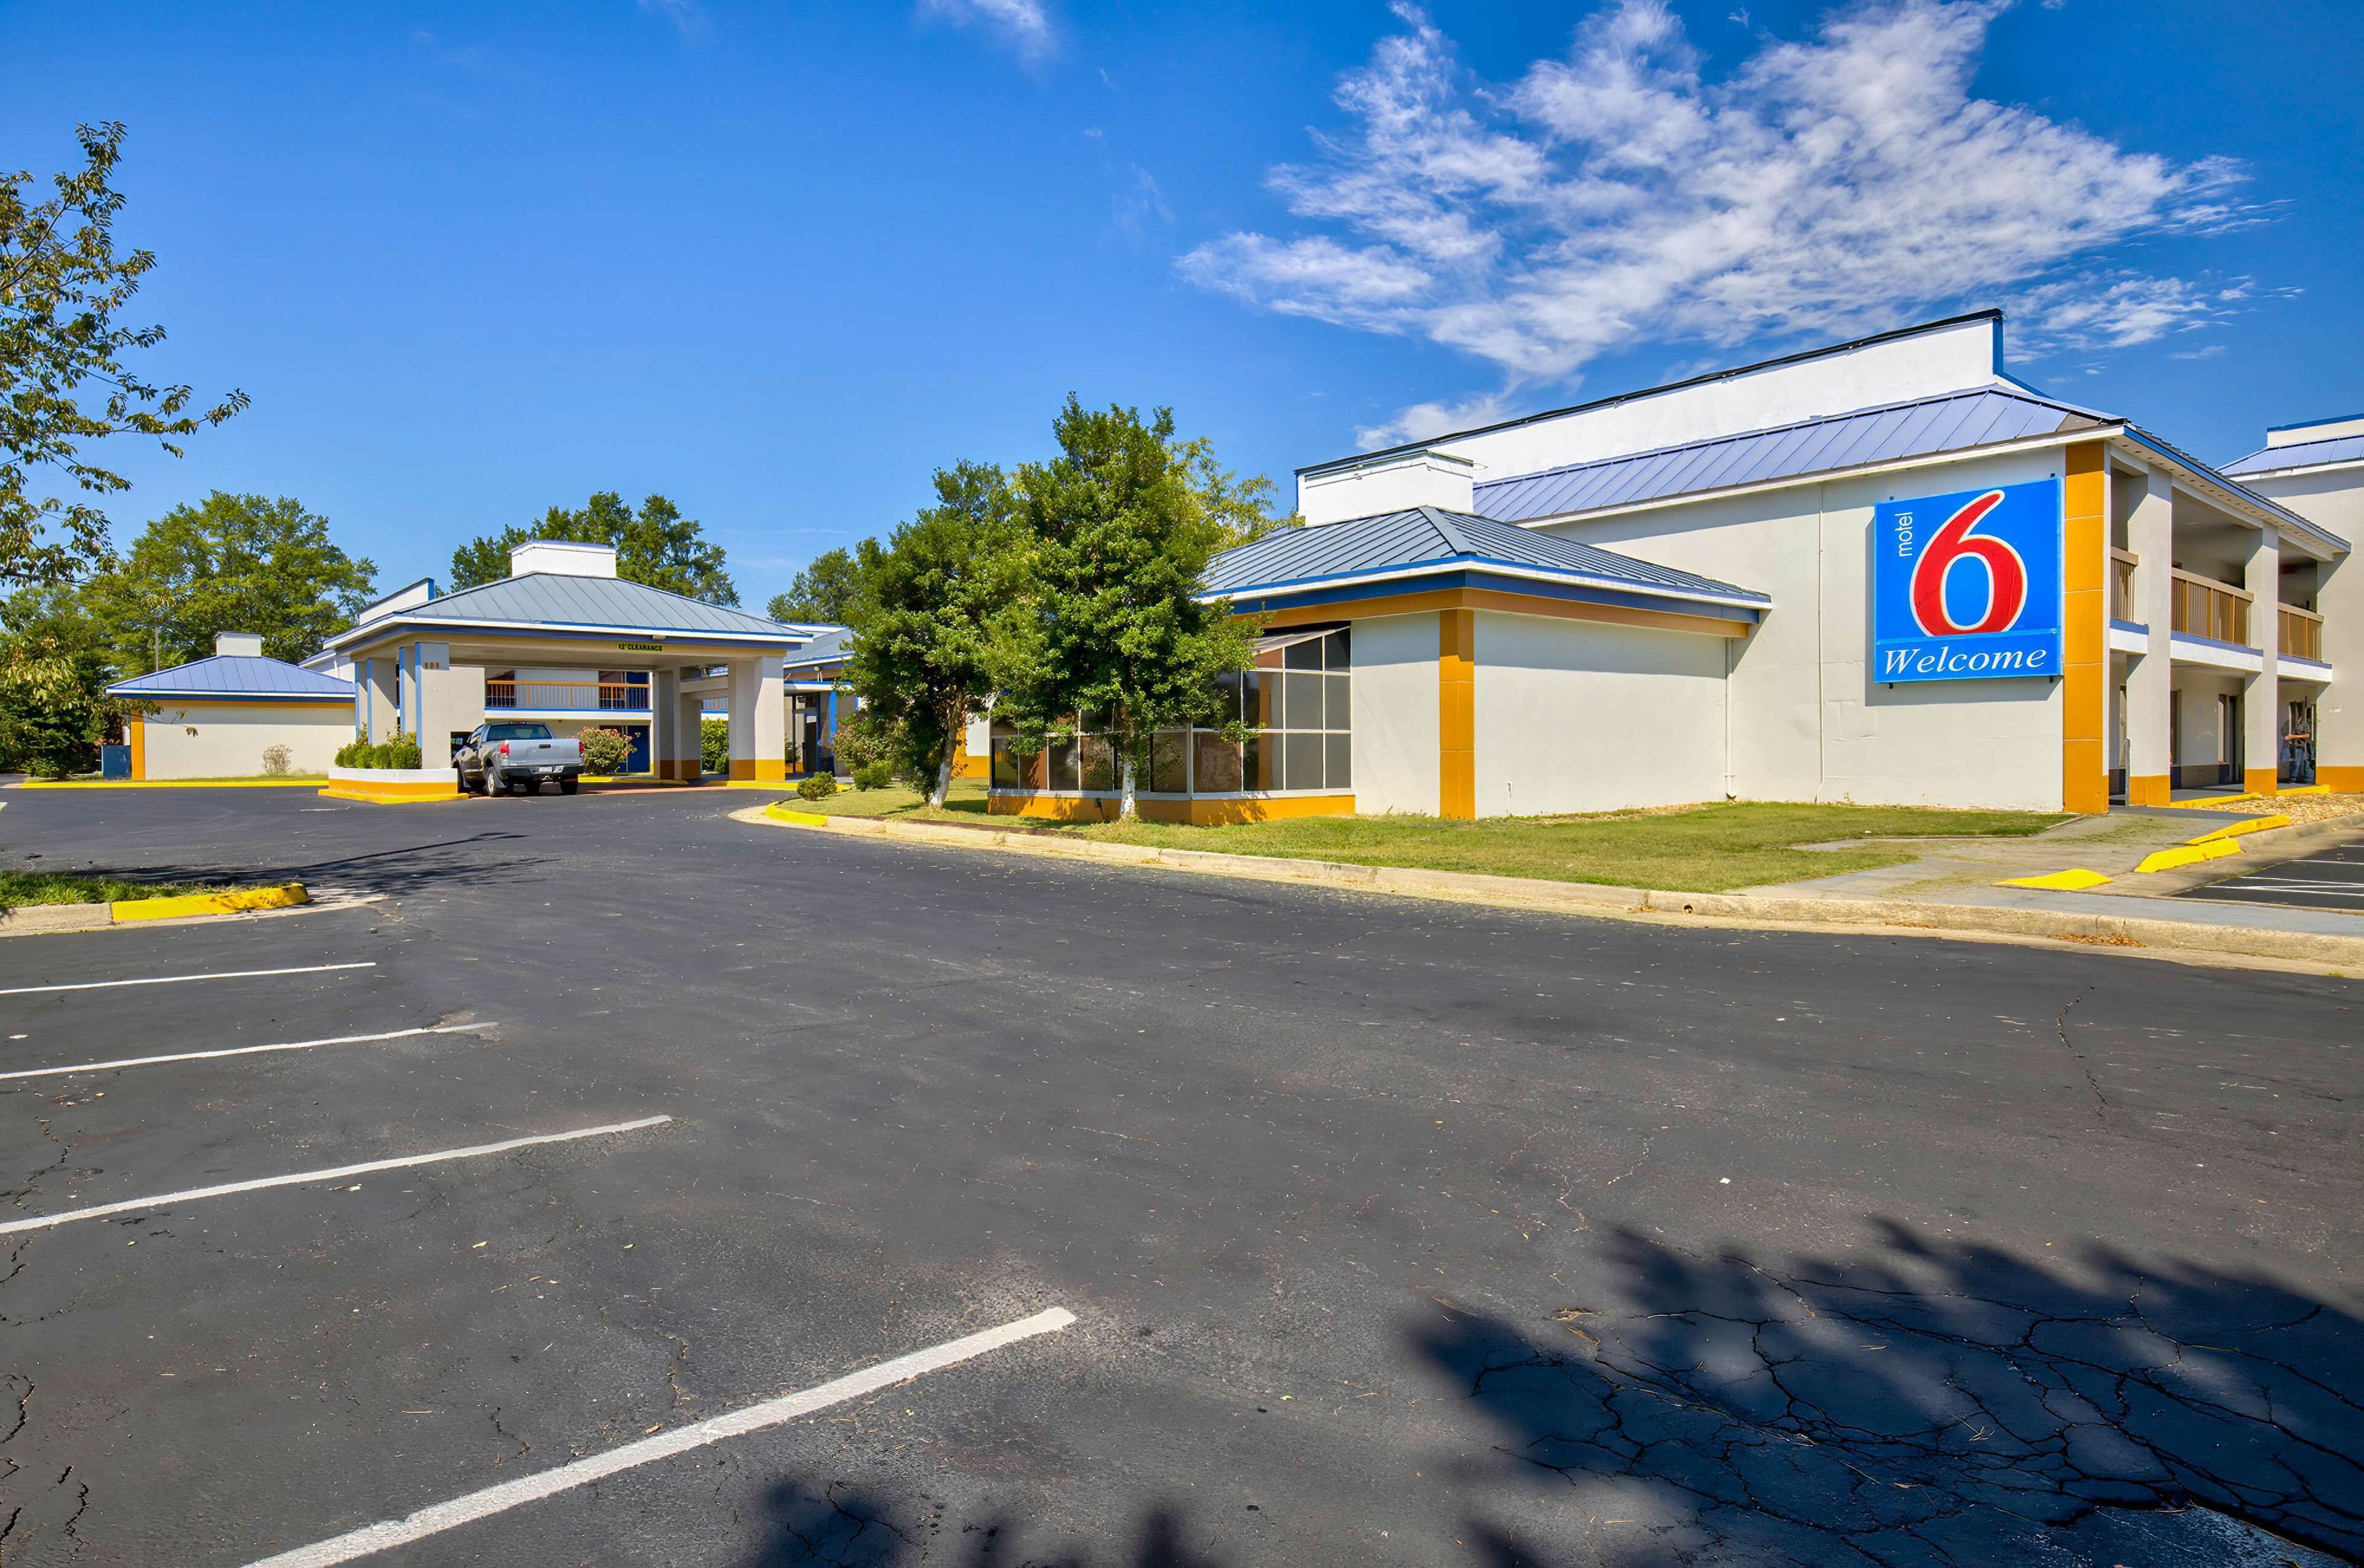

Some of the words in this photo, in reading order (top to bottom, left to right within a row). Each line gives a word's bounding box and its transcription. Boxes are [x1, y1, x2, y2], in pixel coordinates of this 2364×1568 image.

[1895, 512, 1913, 557] motel
[1910, 489, 2028, 637] 6
[1885, 646, 2046, 675] Welcome
